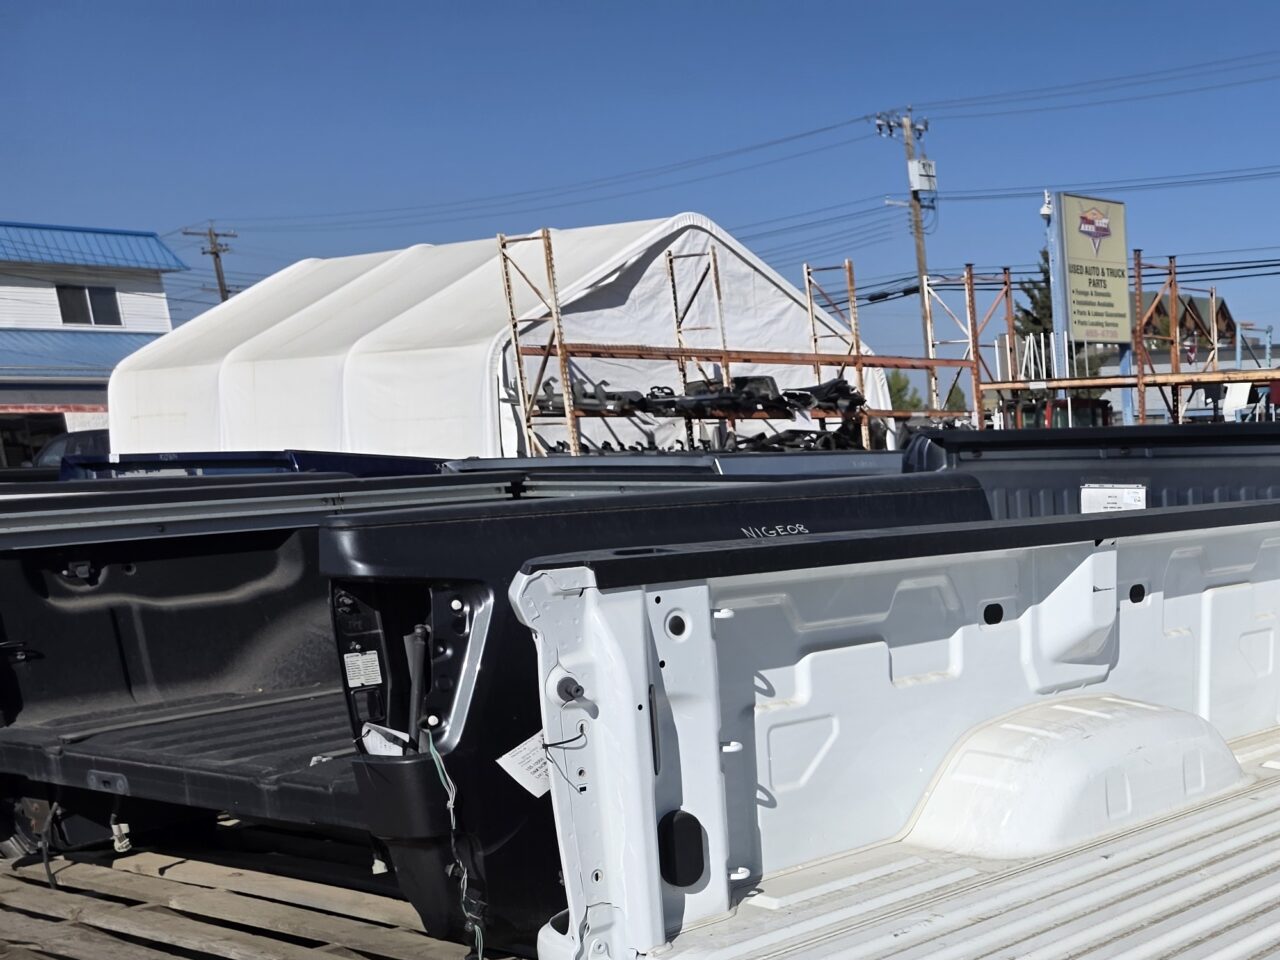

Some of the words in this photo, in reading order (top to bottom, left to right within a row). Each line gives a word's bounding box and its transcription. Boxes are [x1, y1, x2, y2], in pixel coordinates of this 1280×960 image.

[1068, 264, 1084, 275] USED
[1085, 266, 1099, 276] AUTO
[1106, 268, 1126, 278] TRUCK
[1088, 278, 1107, 289] PARTS
